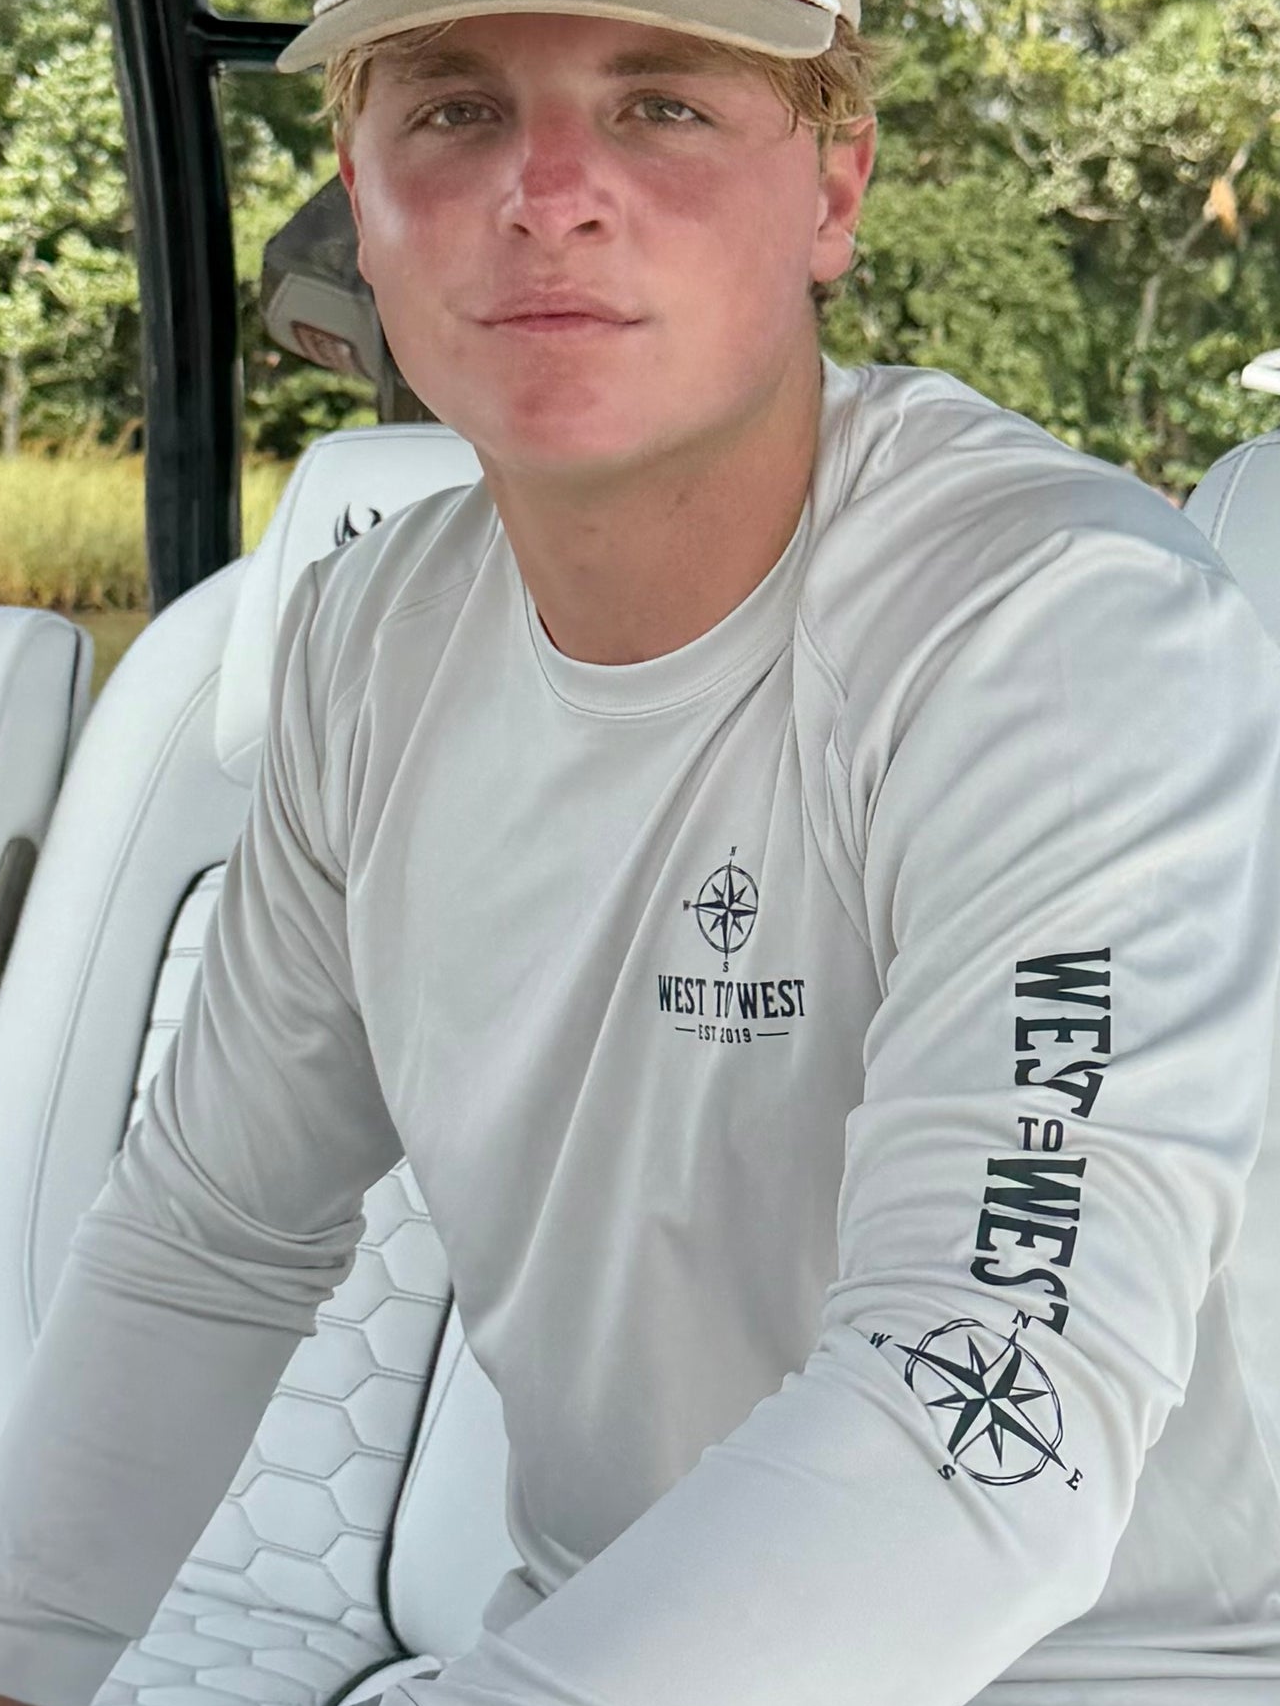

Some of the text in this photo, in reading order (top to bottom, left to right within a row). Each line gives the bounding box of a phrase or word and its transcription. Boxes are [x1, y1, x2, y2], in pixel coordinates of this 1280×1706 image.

[722, 960, 730, 973] S
[657, 974, 806, 1020] WEST TO WEST
[698, 1023, 752, 1044] EST 2019
[1014, 946, 1111, 1119] WEST
[1018, 1116, 1064, 1153] TO
[1011, 1309, 1032, 1329] N
[937, 1463, 957, 1481] S
[1064, 1468, 1084, 1491] E
